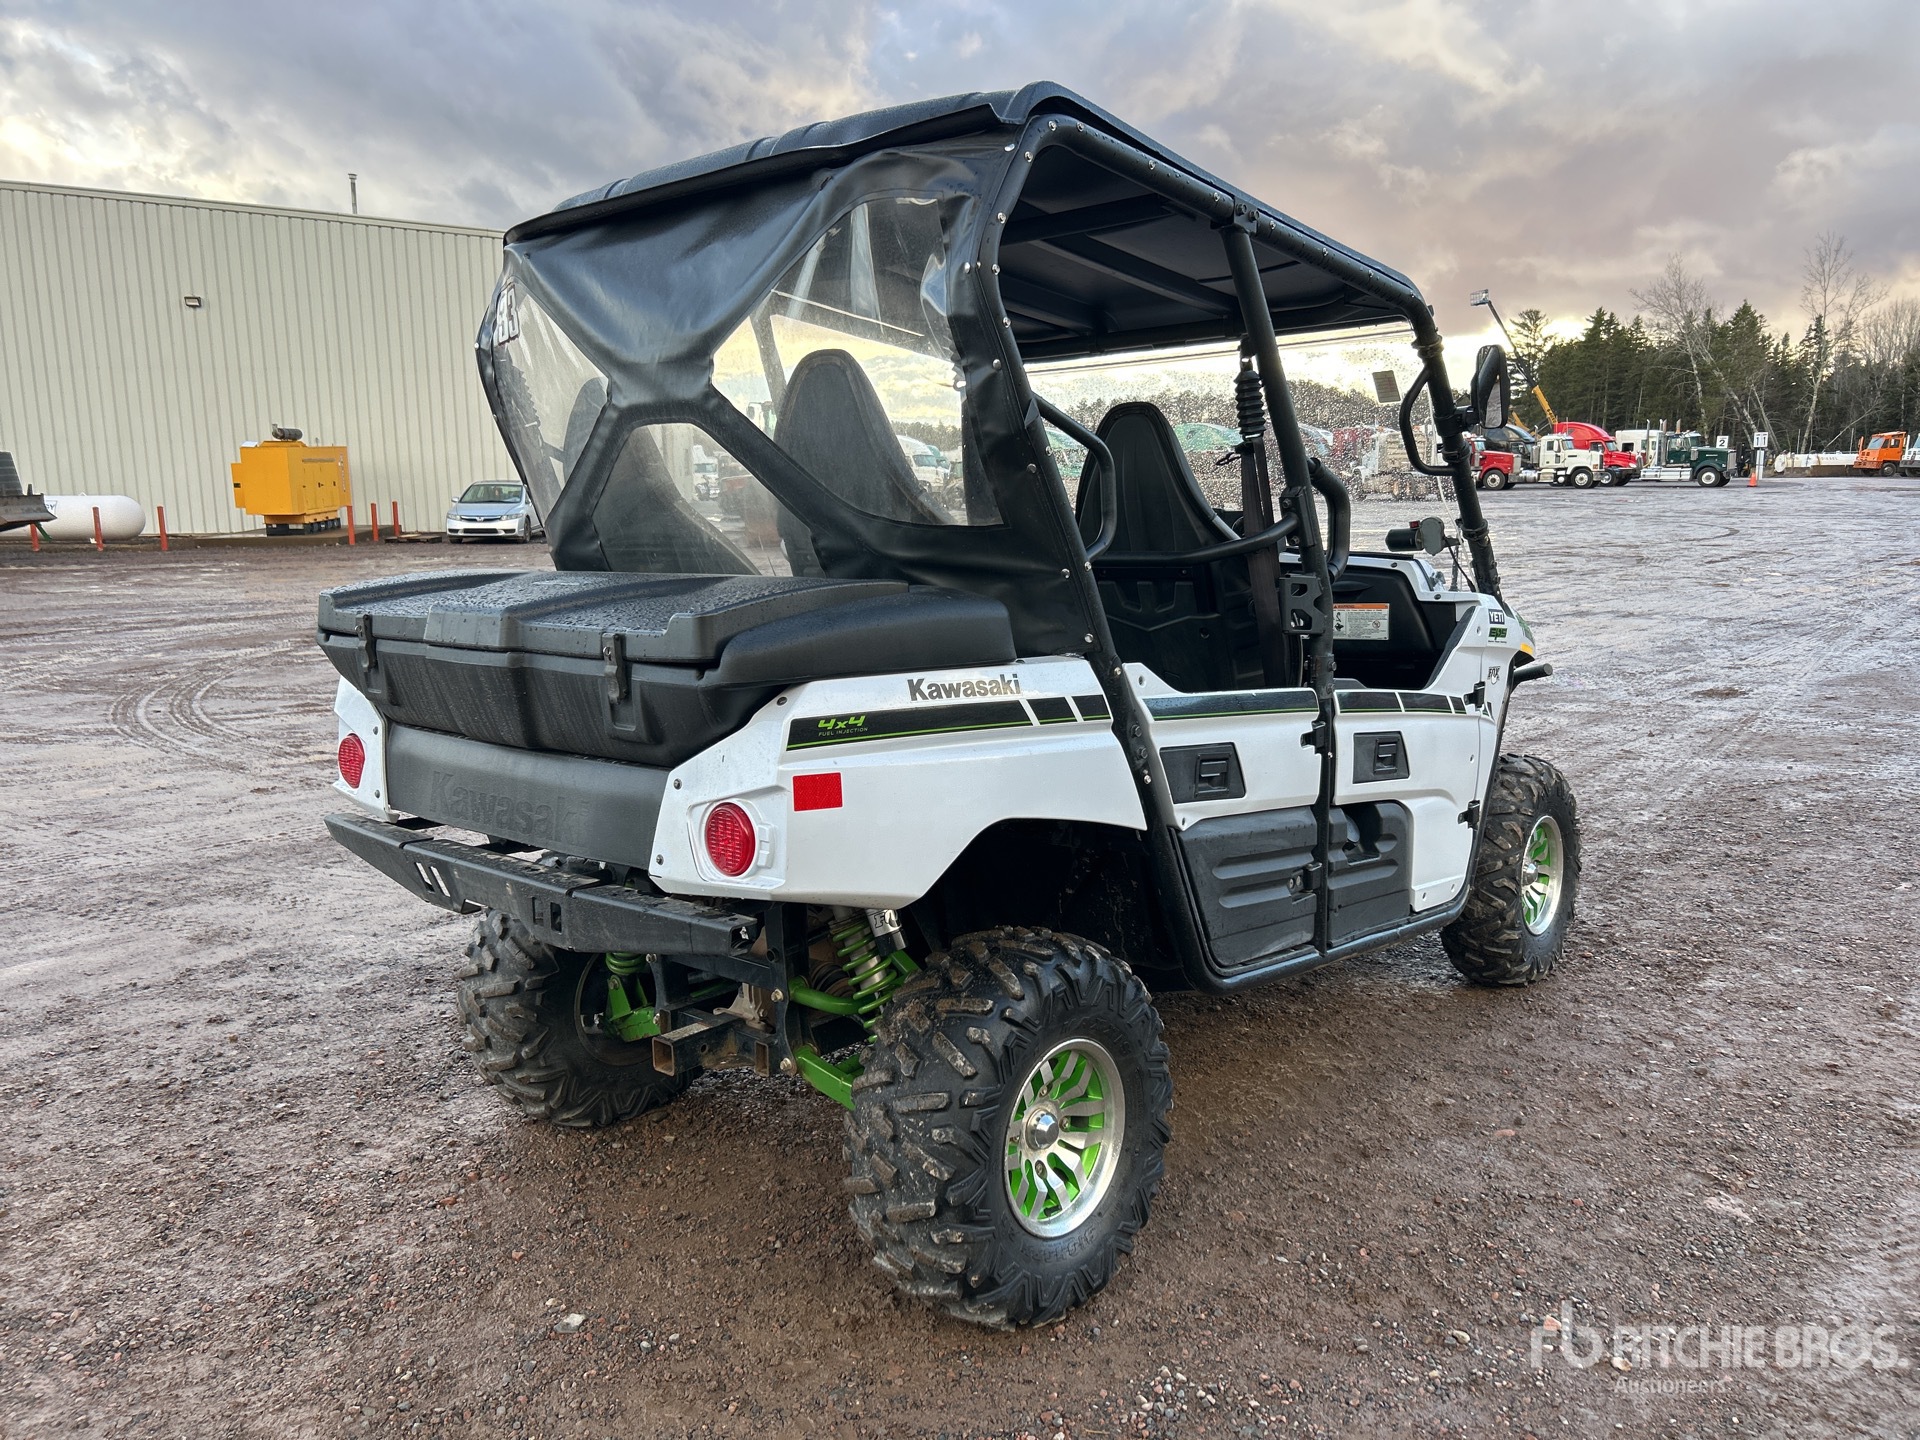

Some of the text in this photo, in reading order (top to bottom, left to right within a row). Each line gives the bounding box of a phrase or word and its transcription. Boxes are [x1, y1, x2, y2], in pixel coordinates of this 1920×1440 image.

[1490, 611, 1504, 623] YETI
[907, 673, 1021, 701] Kawasaki
[818, 715, 866, 730] 4x4
[836, 727, 868, 735] INJECTION
